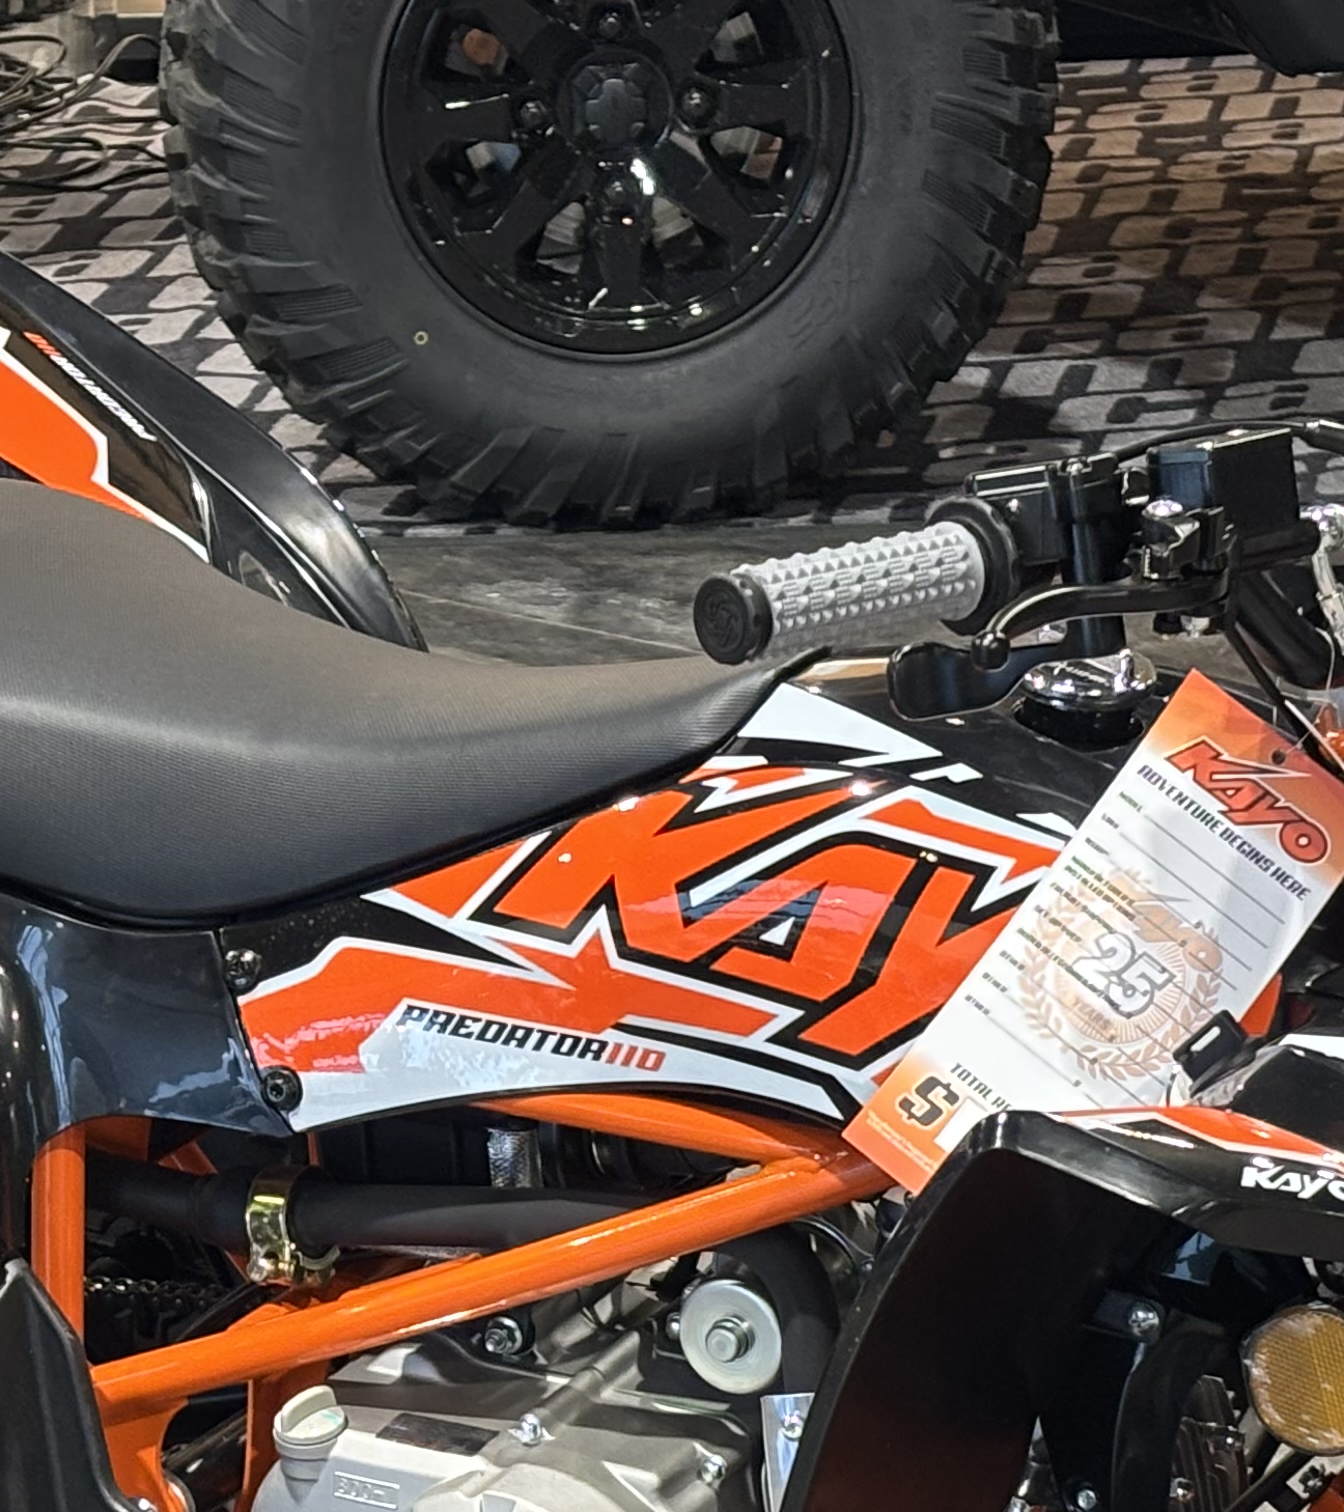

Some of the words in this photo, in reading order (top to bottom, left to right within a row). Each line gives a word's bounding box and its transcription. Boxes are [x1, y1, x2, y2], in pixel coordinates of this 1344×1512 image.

[1135, 762, 1224, 836] ADVENTURE
[1217, 825, 1275, 874] BEGINS
[1268, 864, 1312, 904] HERE
[1166, 737, 1328, 864] KAYO
[494, 779, 1022, 1057] KAY
[395, 1003, 667, 1073] PREDATOR110
[948, 1061, 995, 1103] TOTAL
